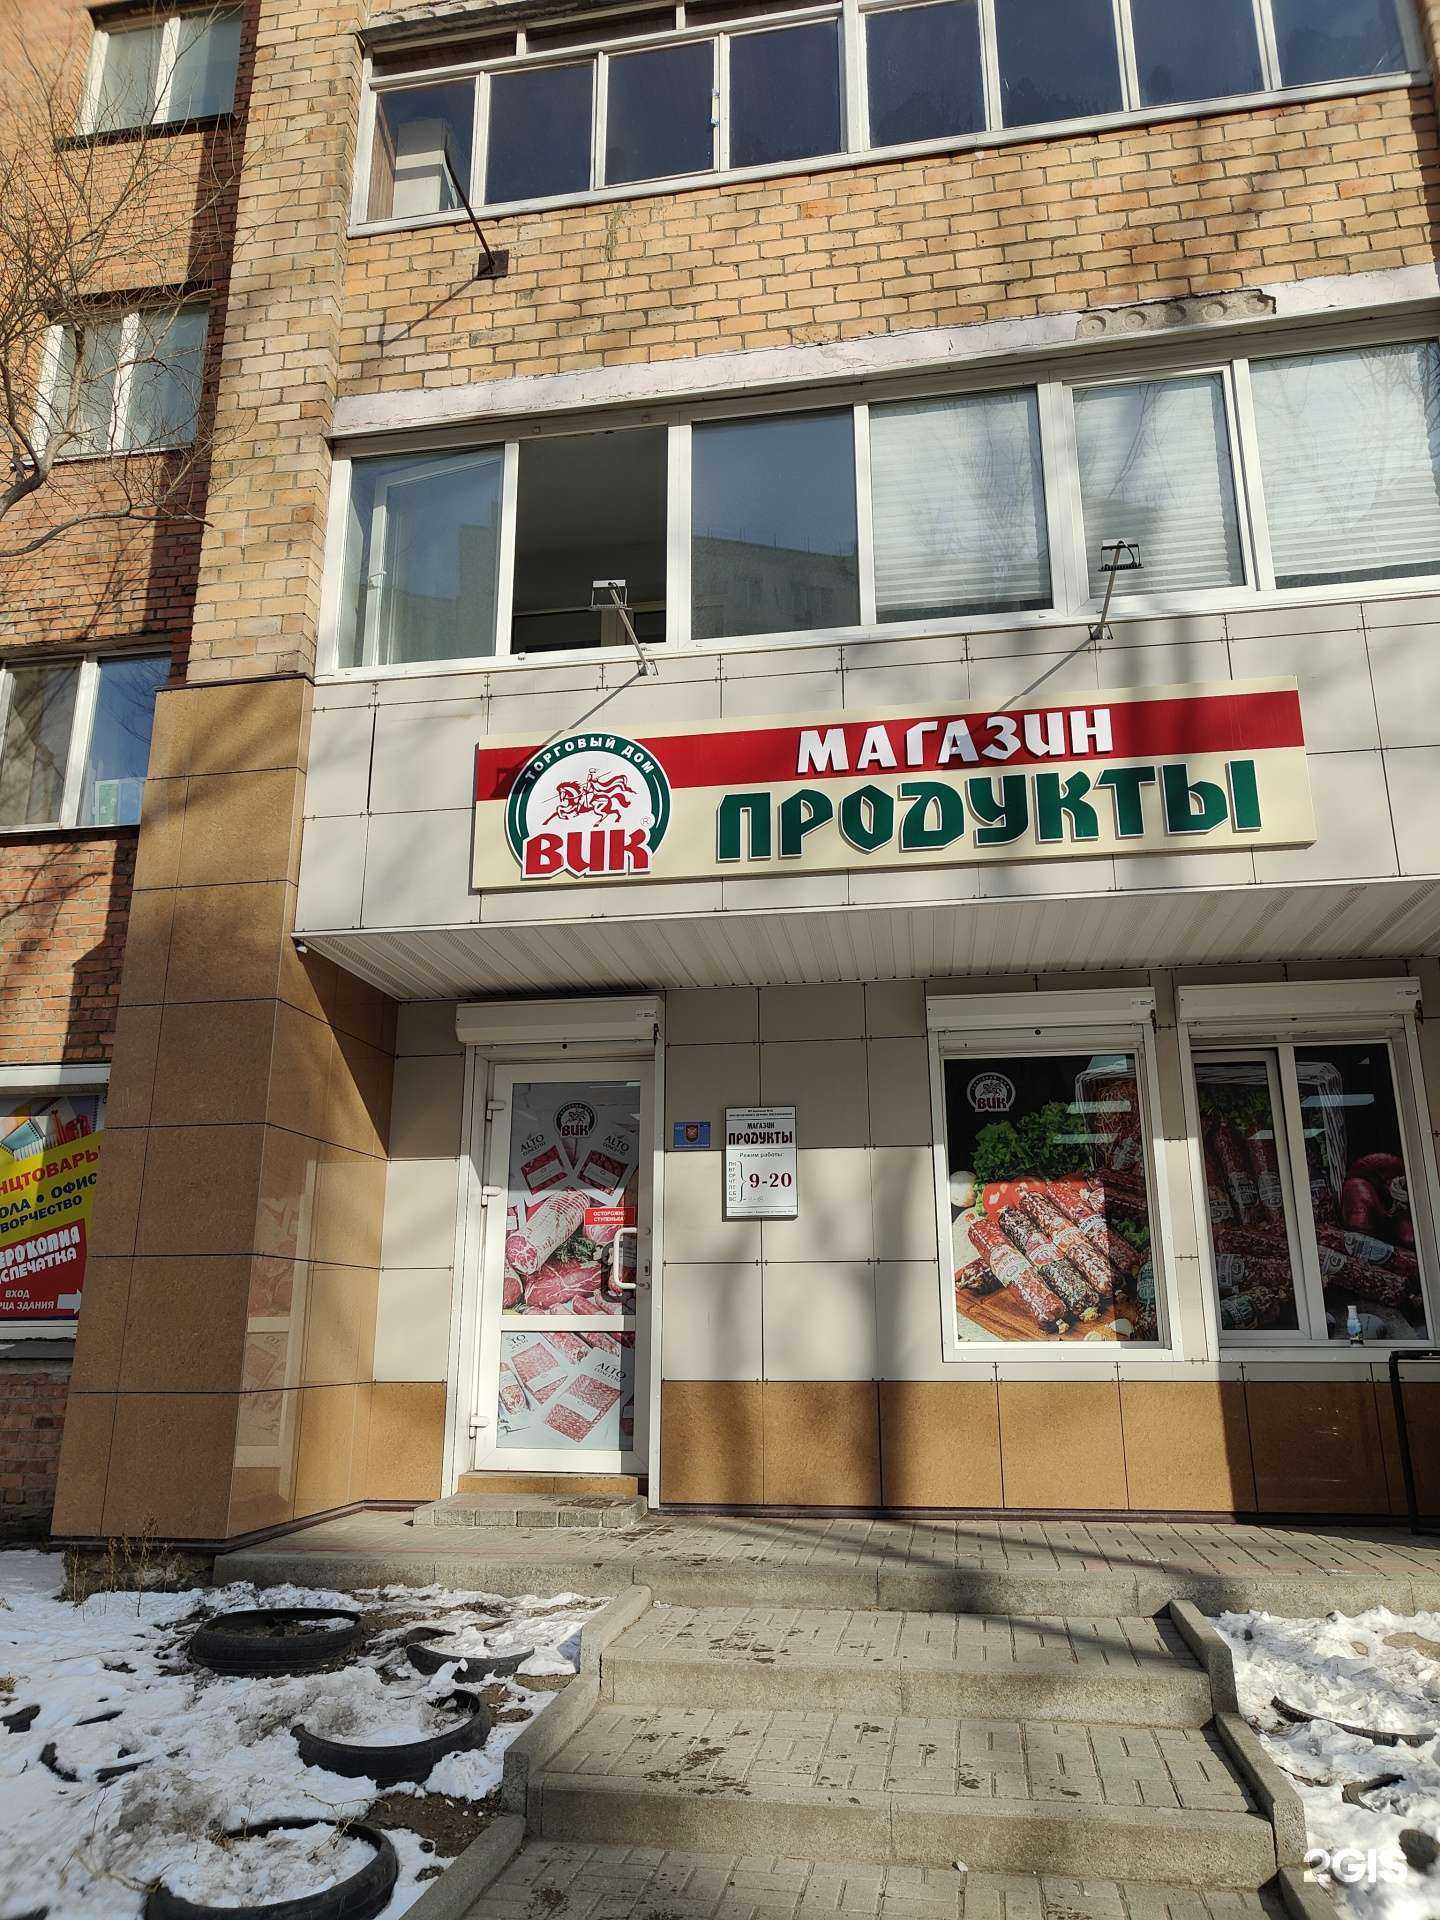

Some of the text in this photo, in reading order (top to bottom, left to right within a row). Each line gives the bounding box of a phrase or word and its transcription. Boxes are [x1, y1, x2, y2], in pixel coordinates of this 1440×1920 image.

[797, 709, 1113, 774] МАГАЗИН
[525, 737, 655, 780] ТОРГОВЫЙ ДОМ
[717, 759, 1262, 862] ПРОДУКТЫ
[525, 827, 650, 876] ВИК
[747, 1122, 775, 1130] МАГАЗИН
[521, 1135, 545, 1152] ALTO
[604, 1136, 629, 1152] ALTO
[728, 1131, 793, 1146] ПРОДУКТЫ
[51, 1173, 97, 1199] ОФИС
[0, 1246, 77, 1284] СПЕЧАТКА
[5, 1289, 30, 1299] ВХОД
[17, 1301, 54, 1312] ЗДАНИЯ
[595, 1362, 627, 1378] ALTO
